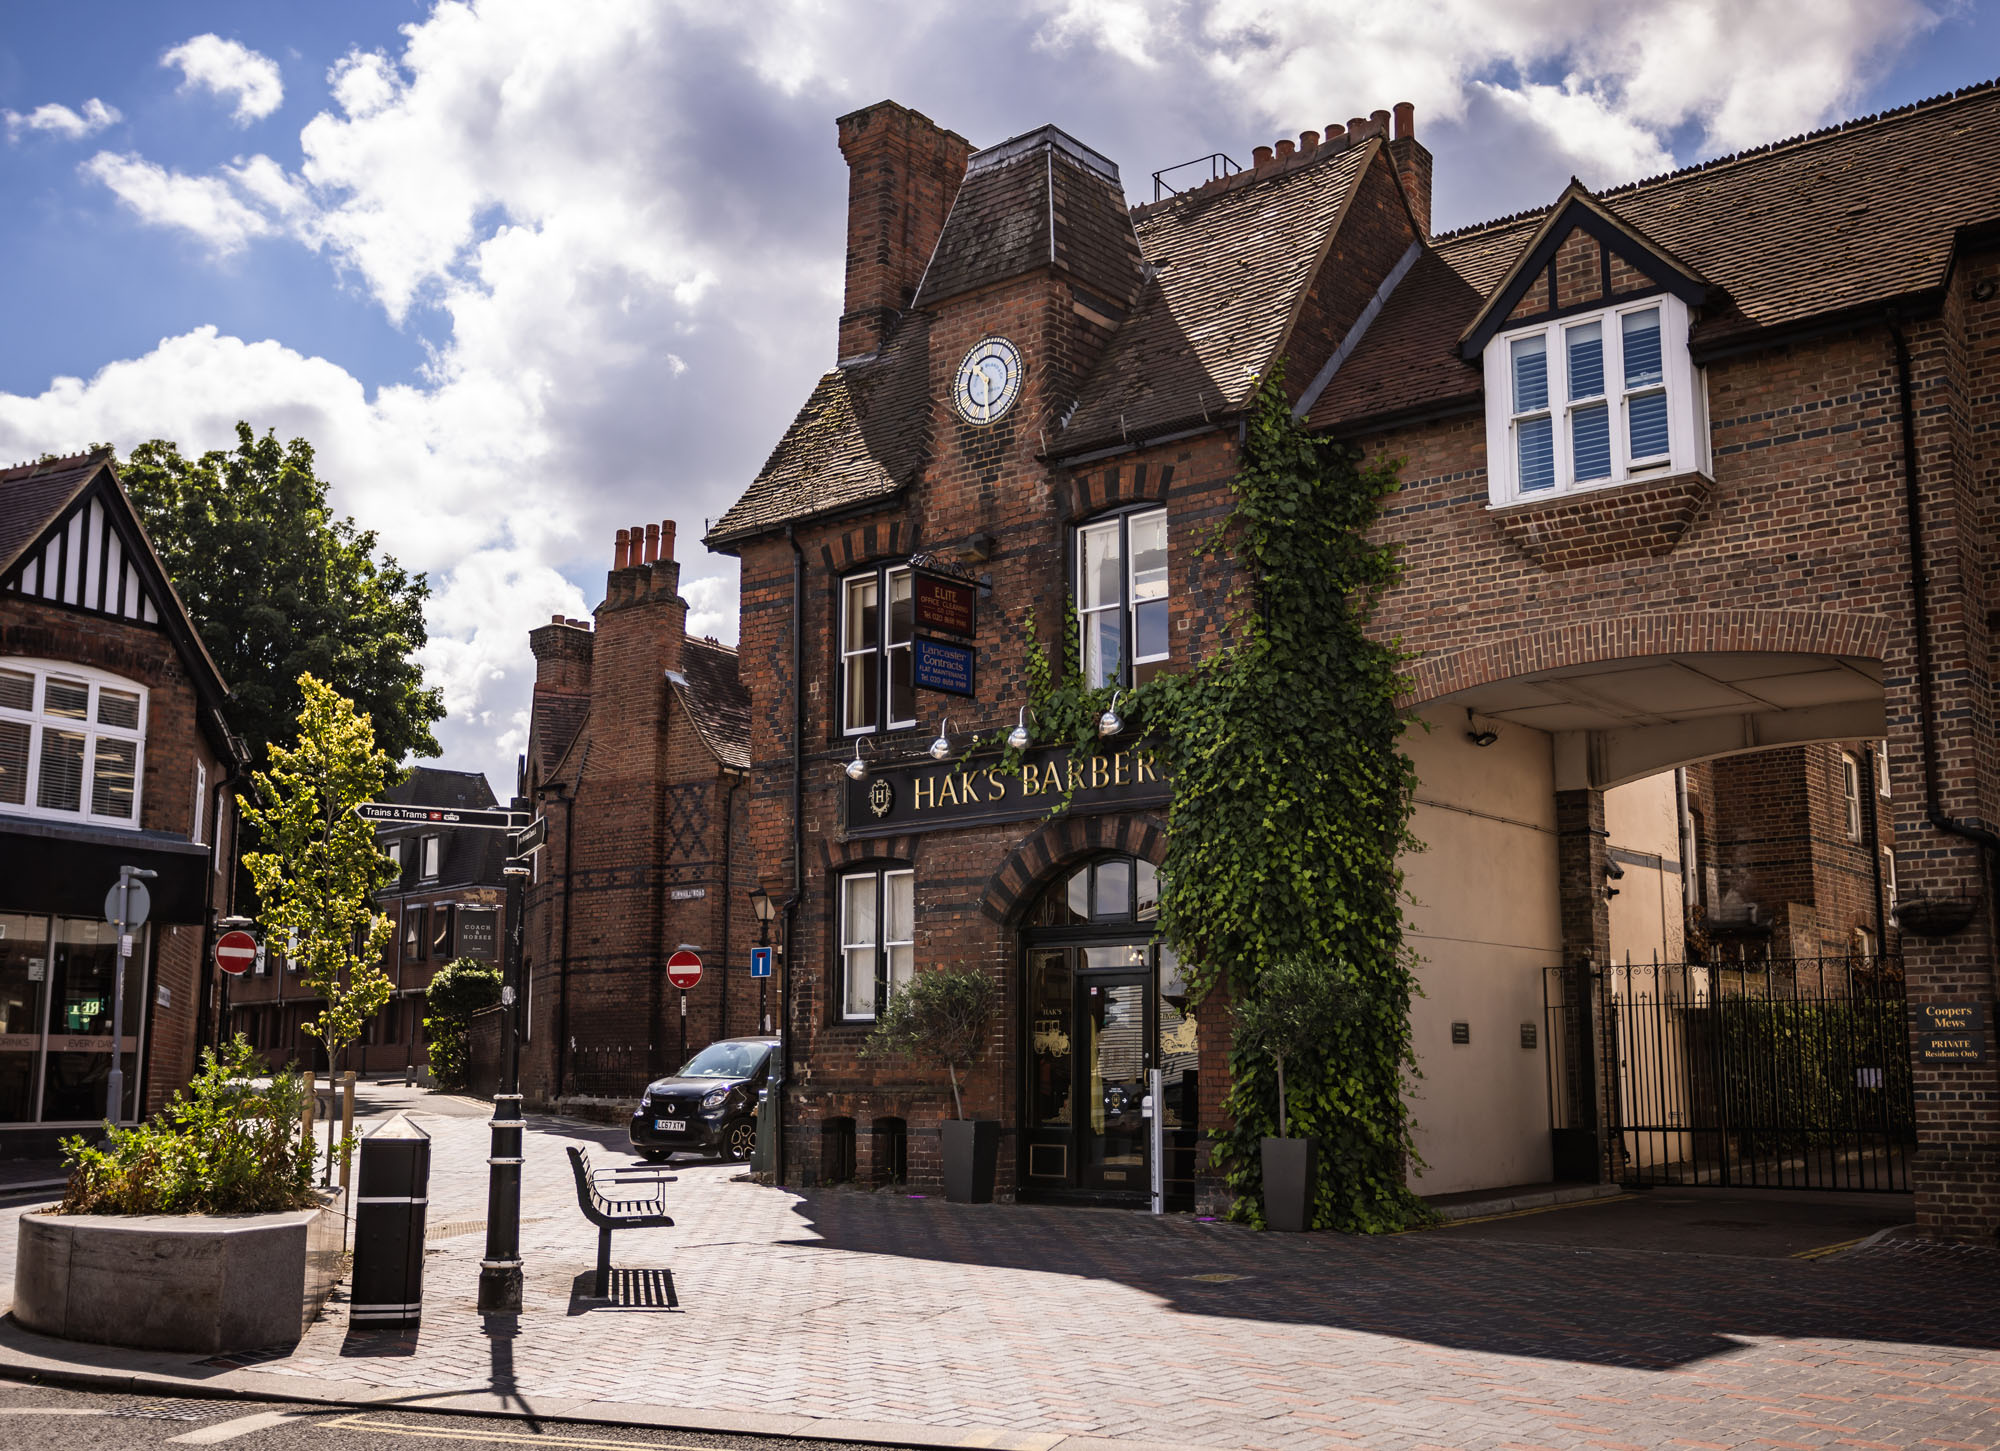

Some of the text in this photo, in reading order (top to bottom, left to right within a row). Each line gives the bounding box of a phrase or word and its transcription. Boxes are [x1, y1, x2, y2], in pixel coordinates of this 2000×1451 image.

[935, 586, 957, 603] ELITE
[922, 643, 967, 661] Lancaster
[923, 654, 964, 672] Contracts
[912, 749, 1171, 811] HAK'S BARBER
[366, 807, 428, 820] Trains & Trams
[1925, 1006, 1973, 1017] Coopers
[1935, 1018, 1966, 1028] Mews
[68, 1038, 95, 1049] EVERY
[1931, 1040, 1971, 1049] PRIVATE
[1960, 1050, 1978, 1059] Only
